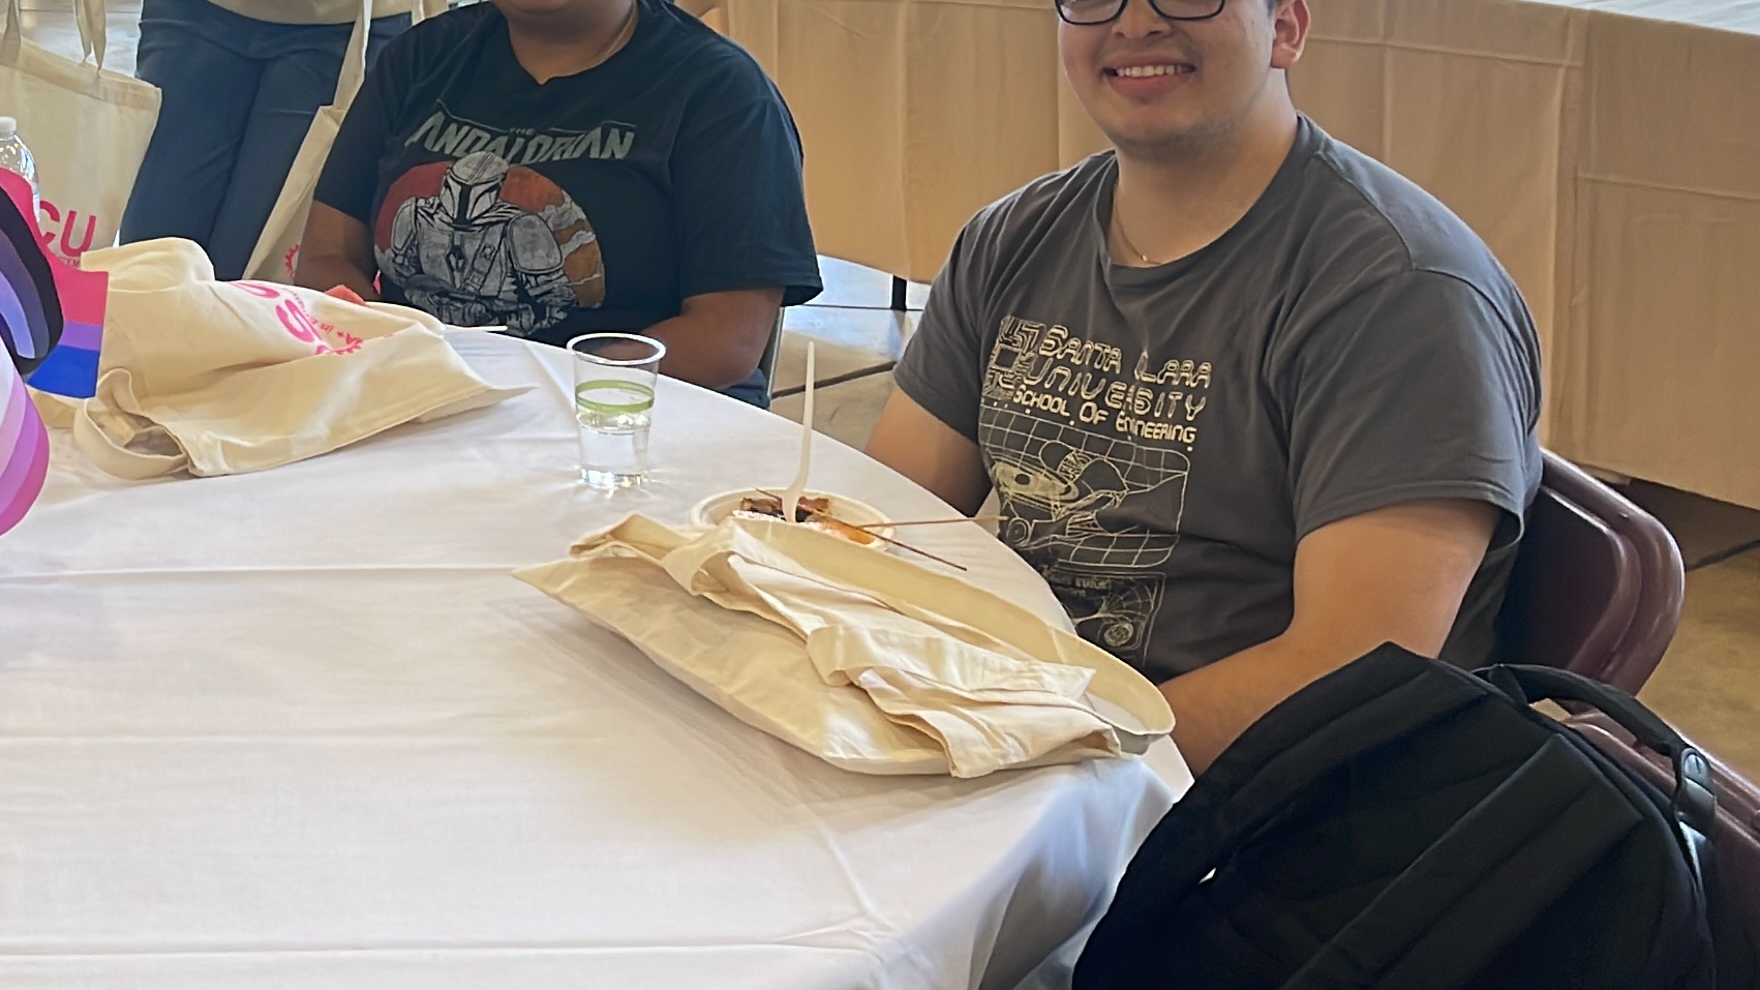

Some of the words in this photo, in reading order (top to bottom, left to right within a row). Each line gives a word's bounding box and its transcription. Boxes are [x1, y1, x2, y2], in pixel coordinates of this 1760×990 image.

[1039, 324, 1123, 375] SANTA
[1012, 384, 1072, 418] SCHOOL
[1078, 401, 1110, 425] OF
[1115, 410, 1198, 443] ENINEERING
